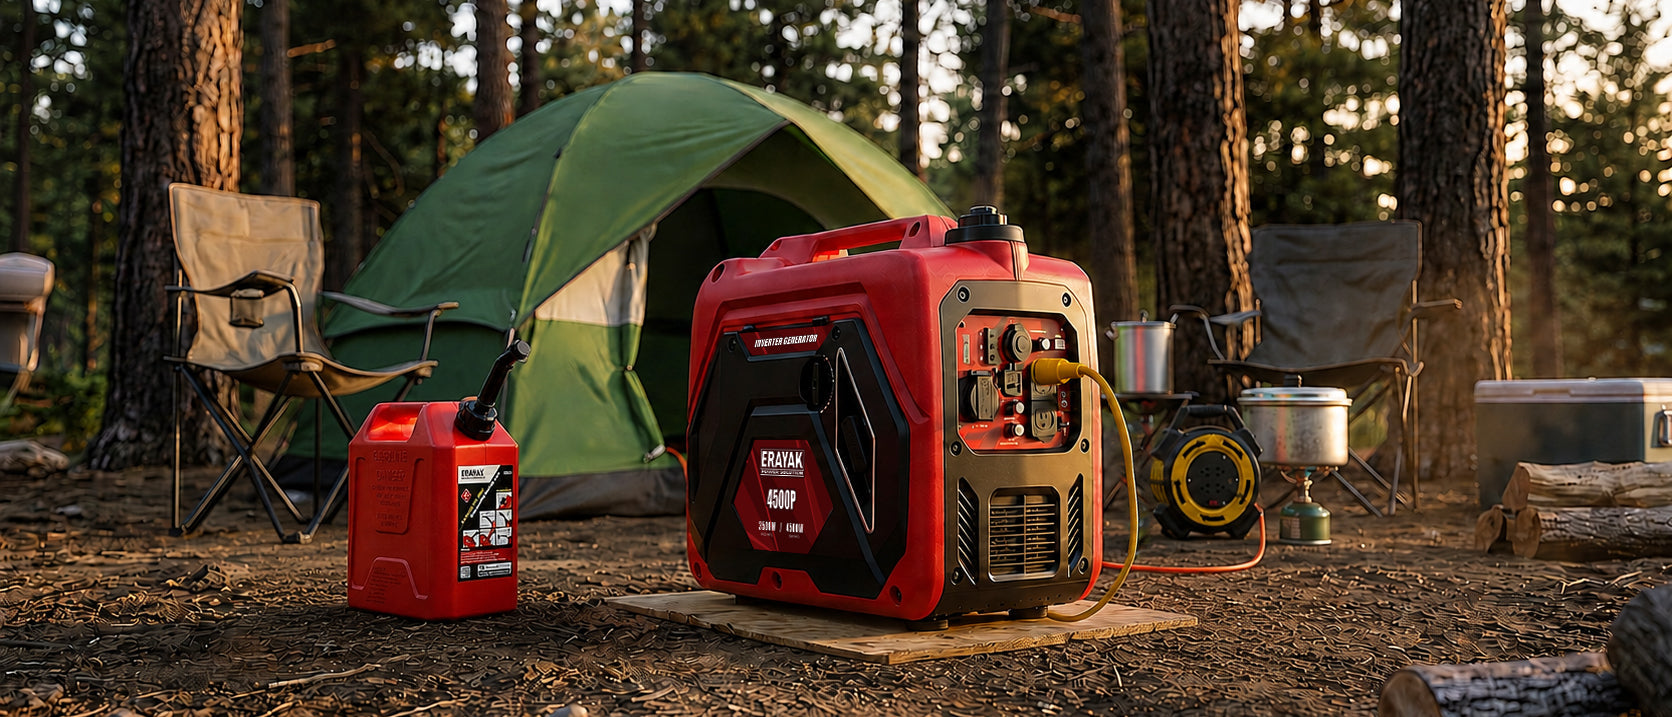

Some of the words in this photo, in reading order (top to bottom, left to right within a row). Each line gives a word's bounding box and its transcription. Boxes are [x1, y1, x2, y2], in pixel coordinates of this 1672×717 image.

[754, 337, 783, 348] INVERTER
[783, 334, 818, 345] GENERATOR
[761, 450, 804, 469] ERAYAK
[767, 488, 797, 510] 4500P
